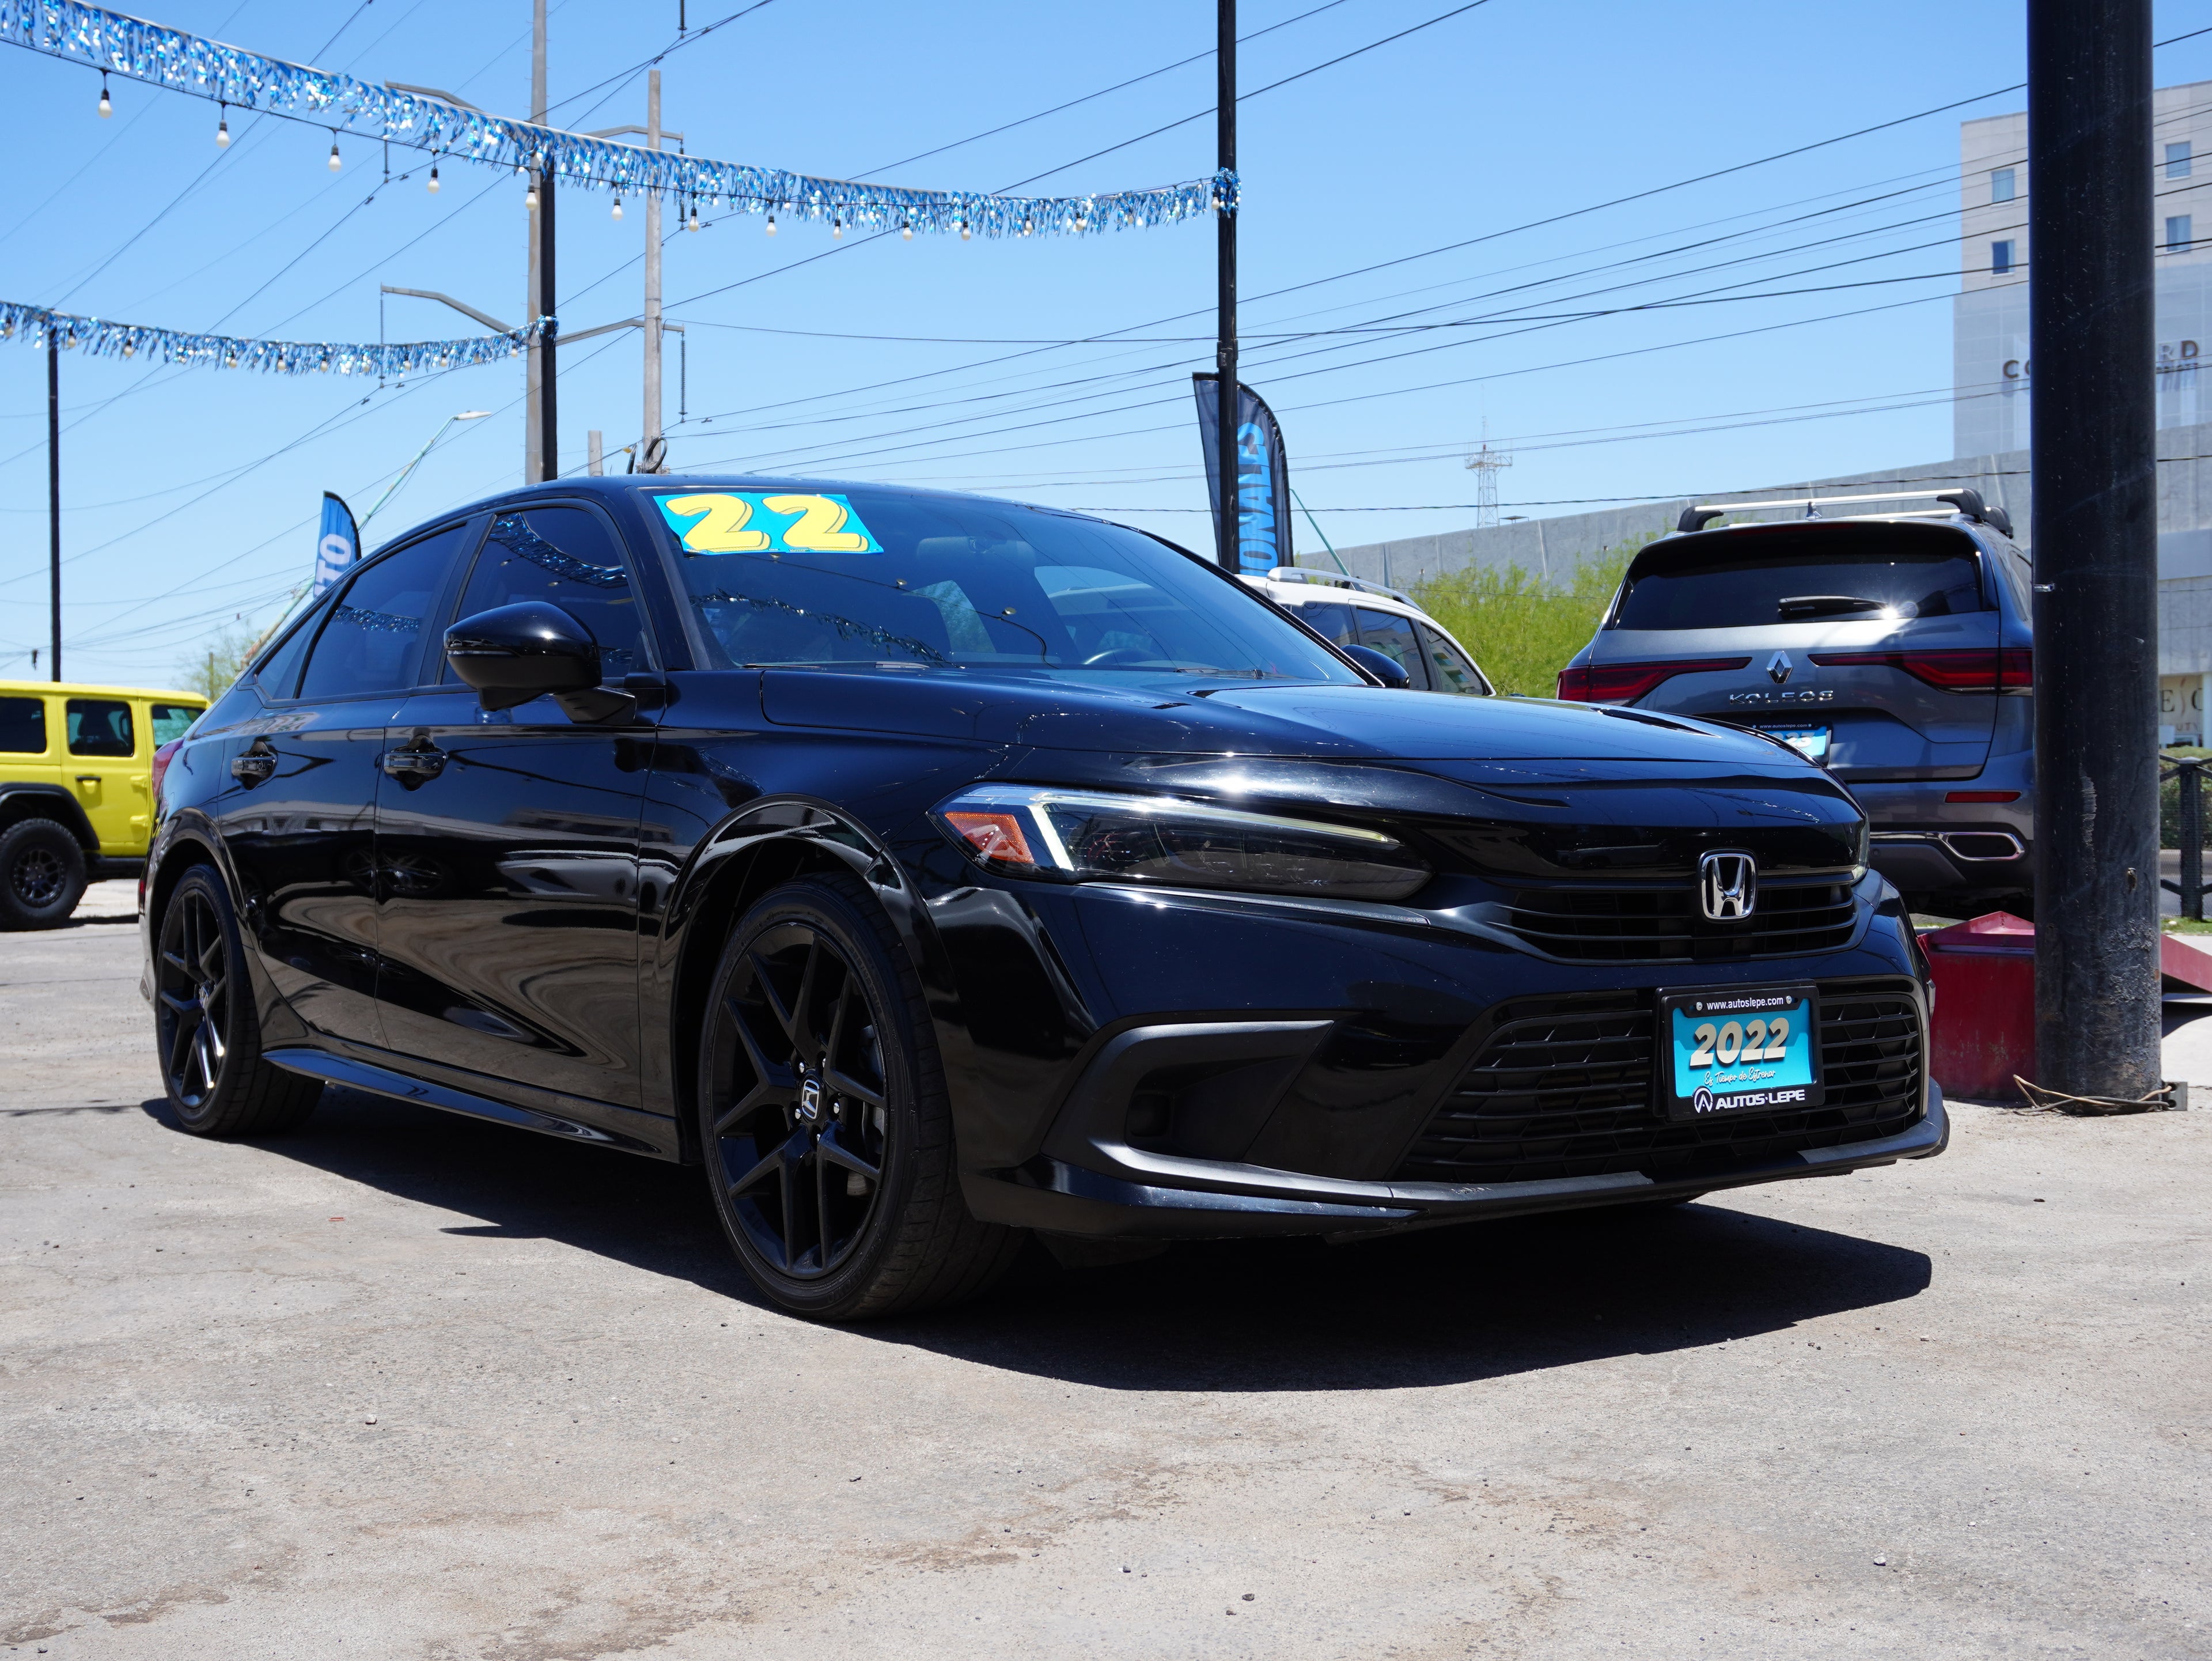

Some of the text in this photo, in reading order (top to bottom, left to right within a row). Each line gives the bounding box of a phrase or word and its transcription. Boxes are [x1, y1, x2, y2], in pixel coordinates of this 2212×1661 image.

[1729, 690, 1834, 705] KOLEOS
[1706, 997, 1784, 1011] www.autoslepe.com
[1690, 1017, 1790, 1066] 2022
[1704, 1067, 1776, 1086] Es Tiempo de Estrenar
